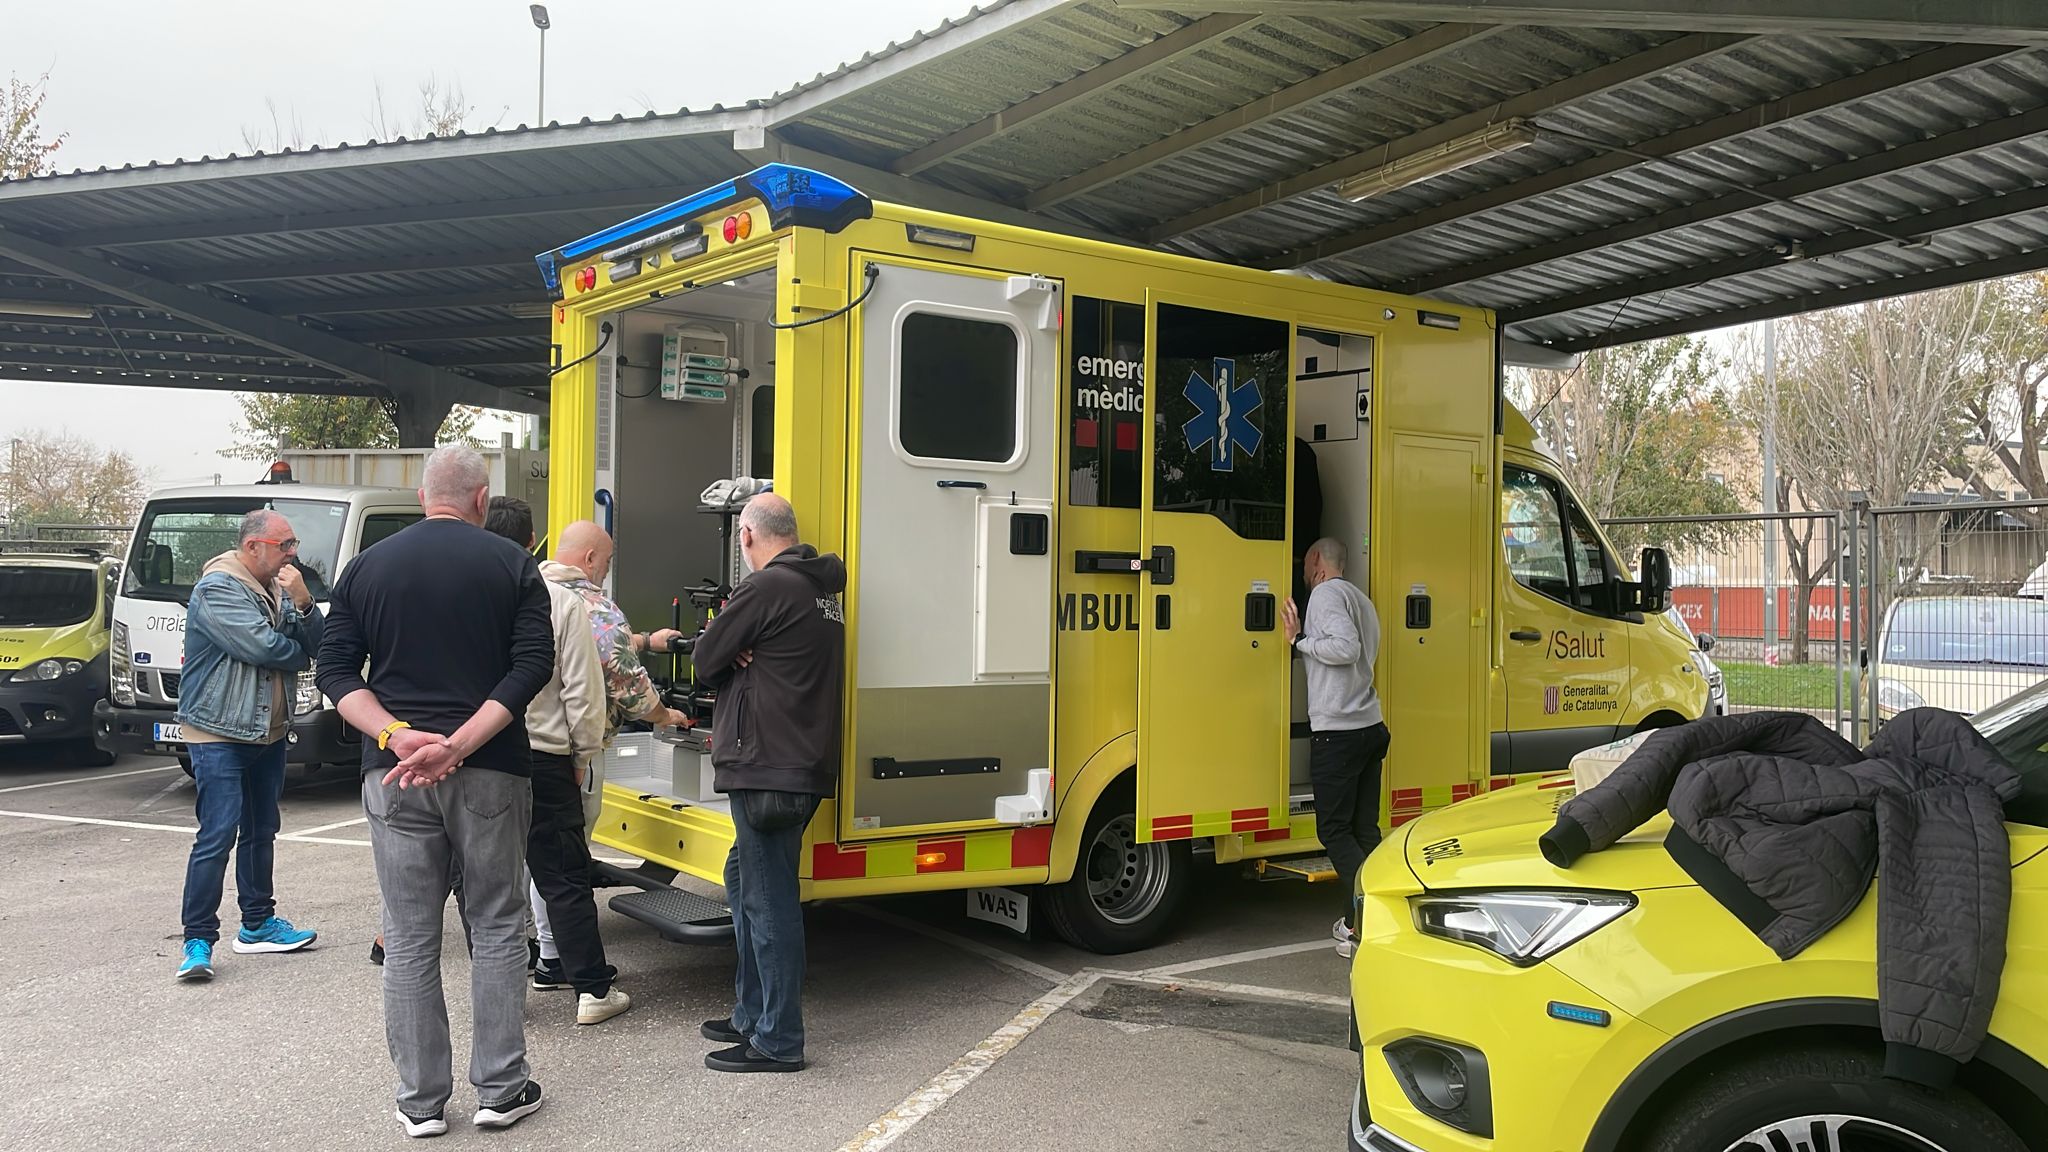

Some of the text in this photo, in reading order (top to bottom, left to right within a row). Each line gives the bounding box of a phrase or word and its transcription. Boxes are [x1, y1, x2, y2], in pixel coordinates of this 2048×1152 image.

[1563, 684, 1609, 697] Generalitat
[1562, 699, 1618, 712] de Catalunya
[977, 891, 1018, 920] WAS
